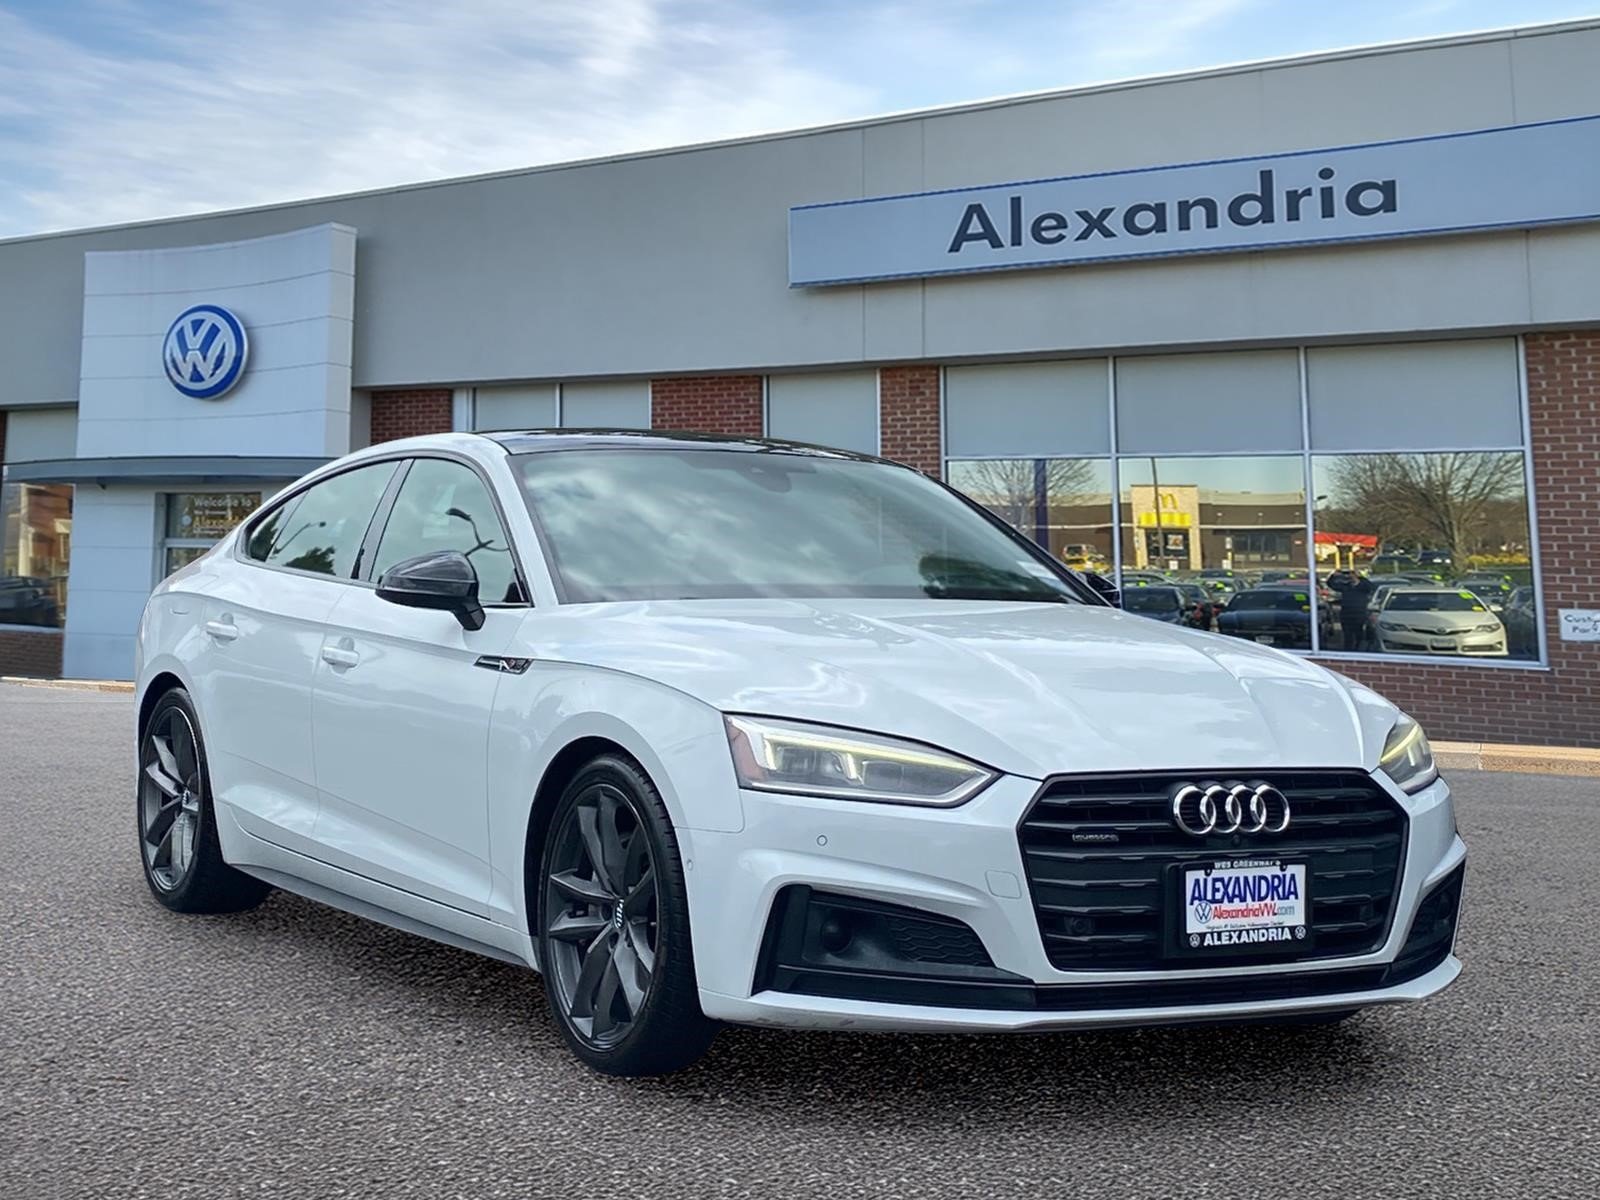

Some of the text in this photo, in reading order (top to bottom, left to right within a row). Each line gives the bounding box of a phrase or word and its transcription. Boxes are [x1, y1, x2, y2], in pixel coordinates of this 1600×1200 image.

[947, 166, 1398, 254] Alexandria
[163, 304, 247, 398] VW
[1189, 873, 1299, 906] ALEXANDRIA
[1203, 927, 1292, 947] ALEXANDRIA
